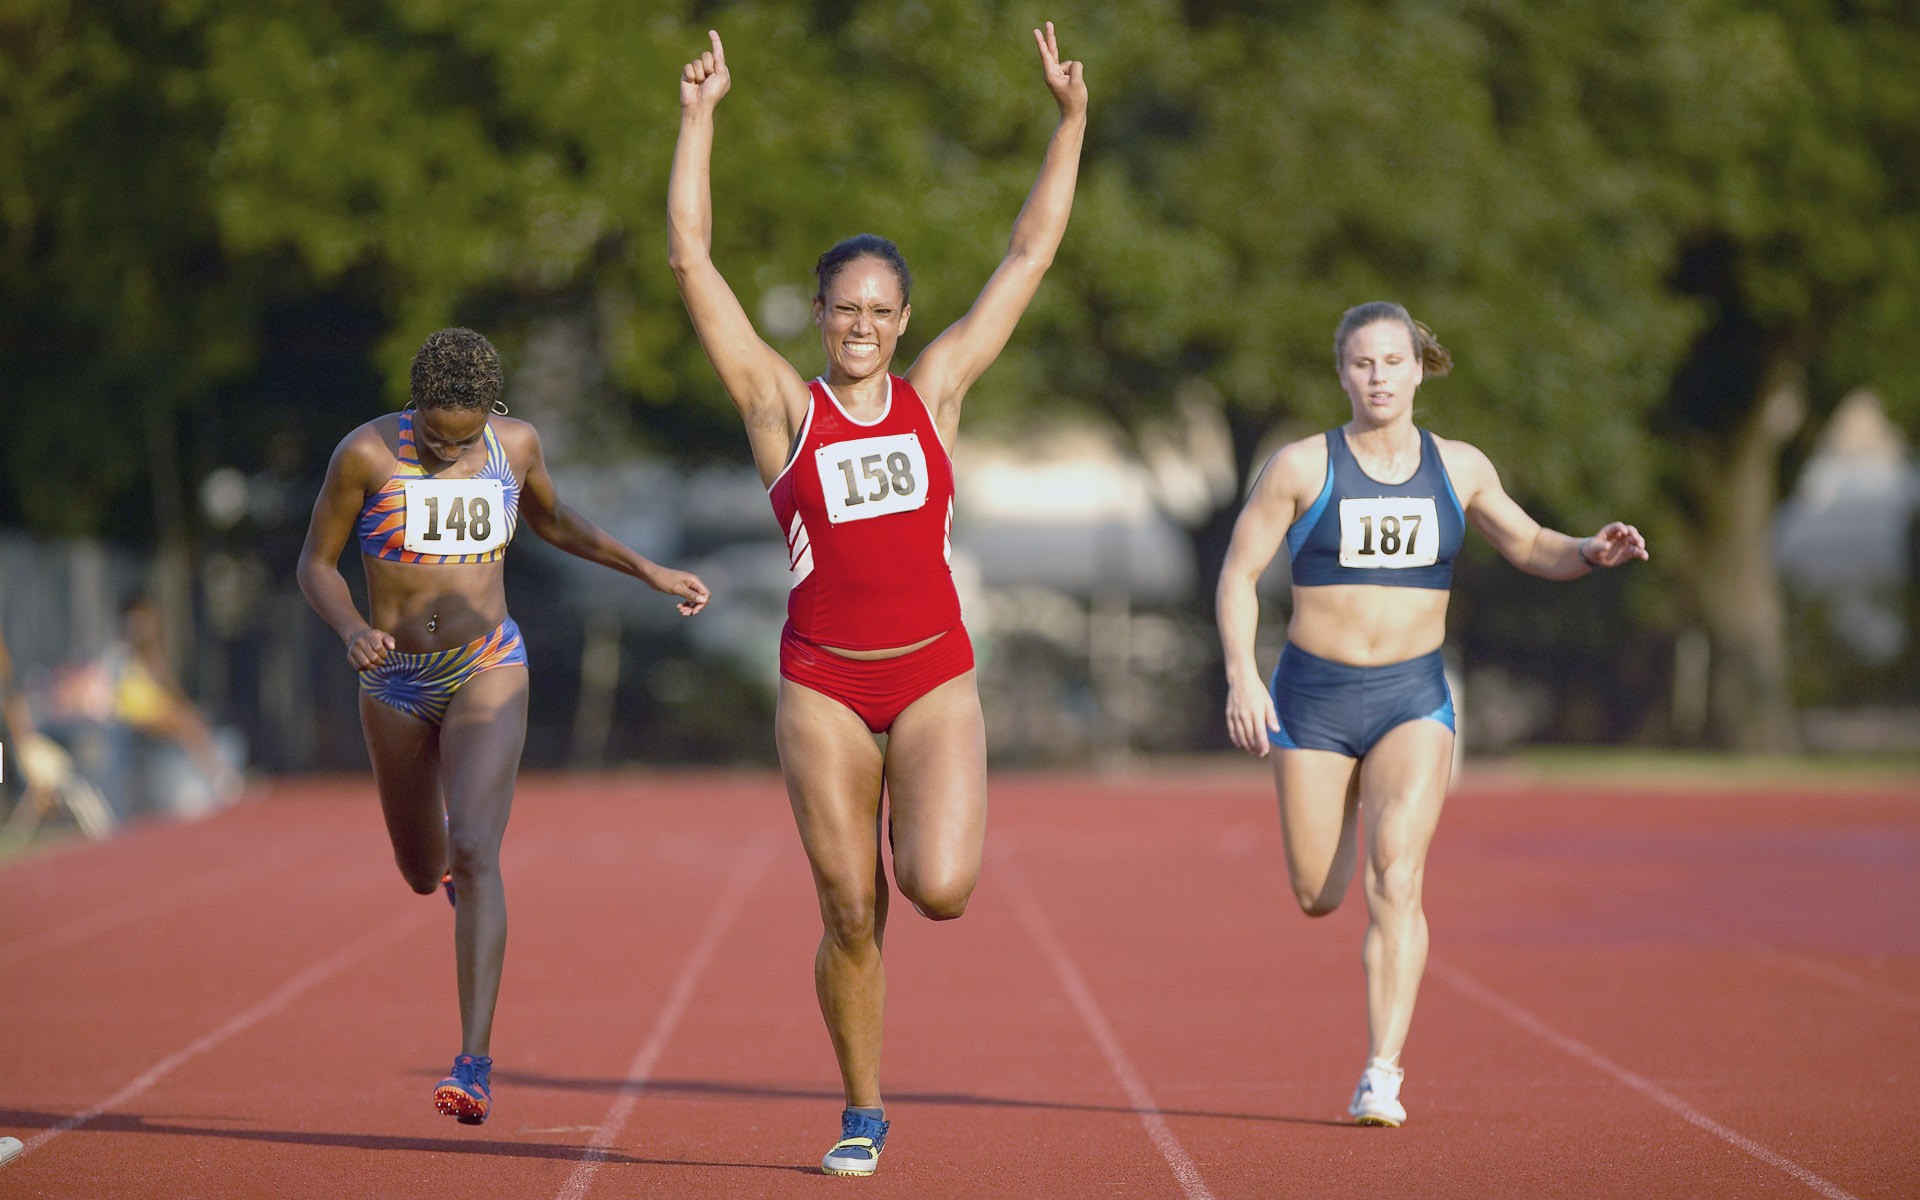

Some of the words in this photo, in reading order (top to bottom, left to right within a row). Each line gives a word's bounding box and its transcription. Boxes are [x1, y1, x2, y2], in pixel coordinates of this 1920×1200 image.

[837, 451, 916, 507] 158
[423, 496, 491, 542] 148
[1358, 515, 1422, 556] 187
